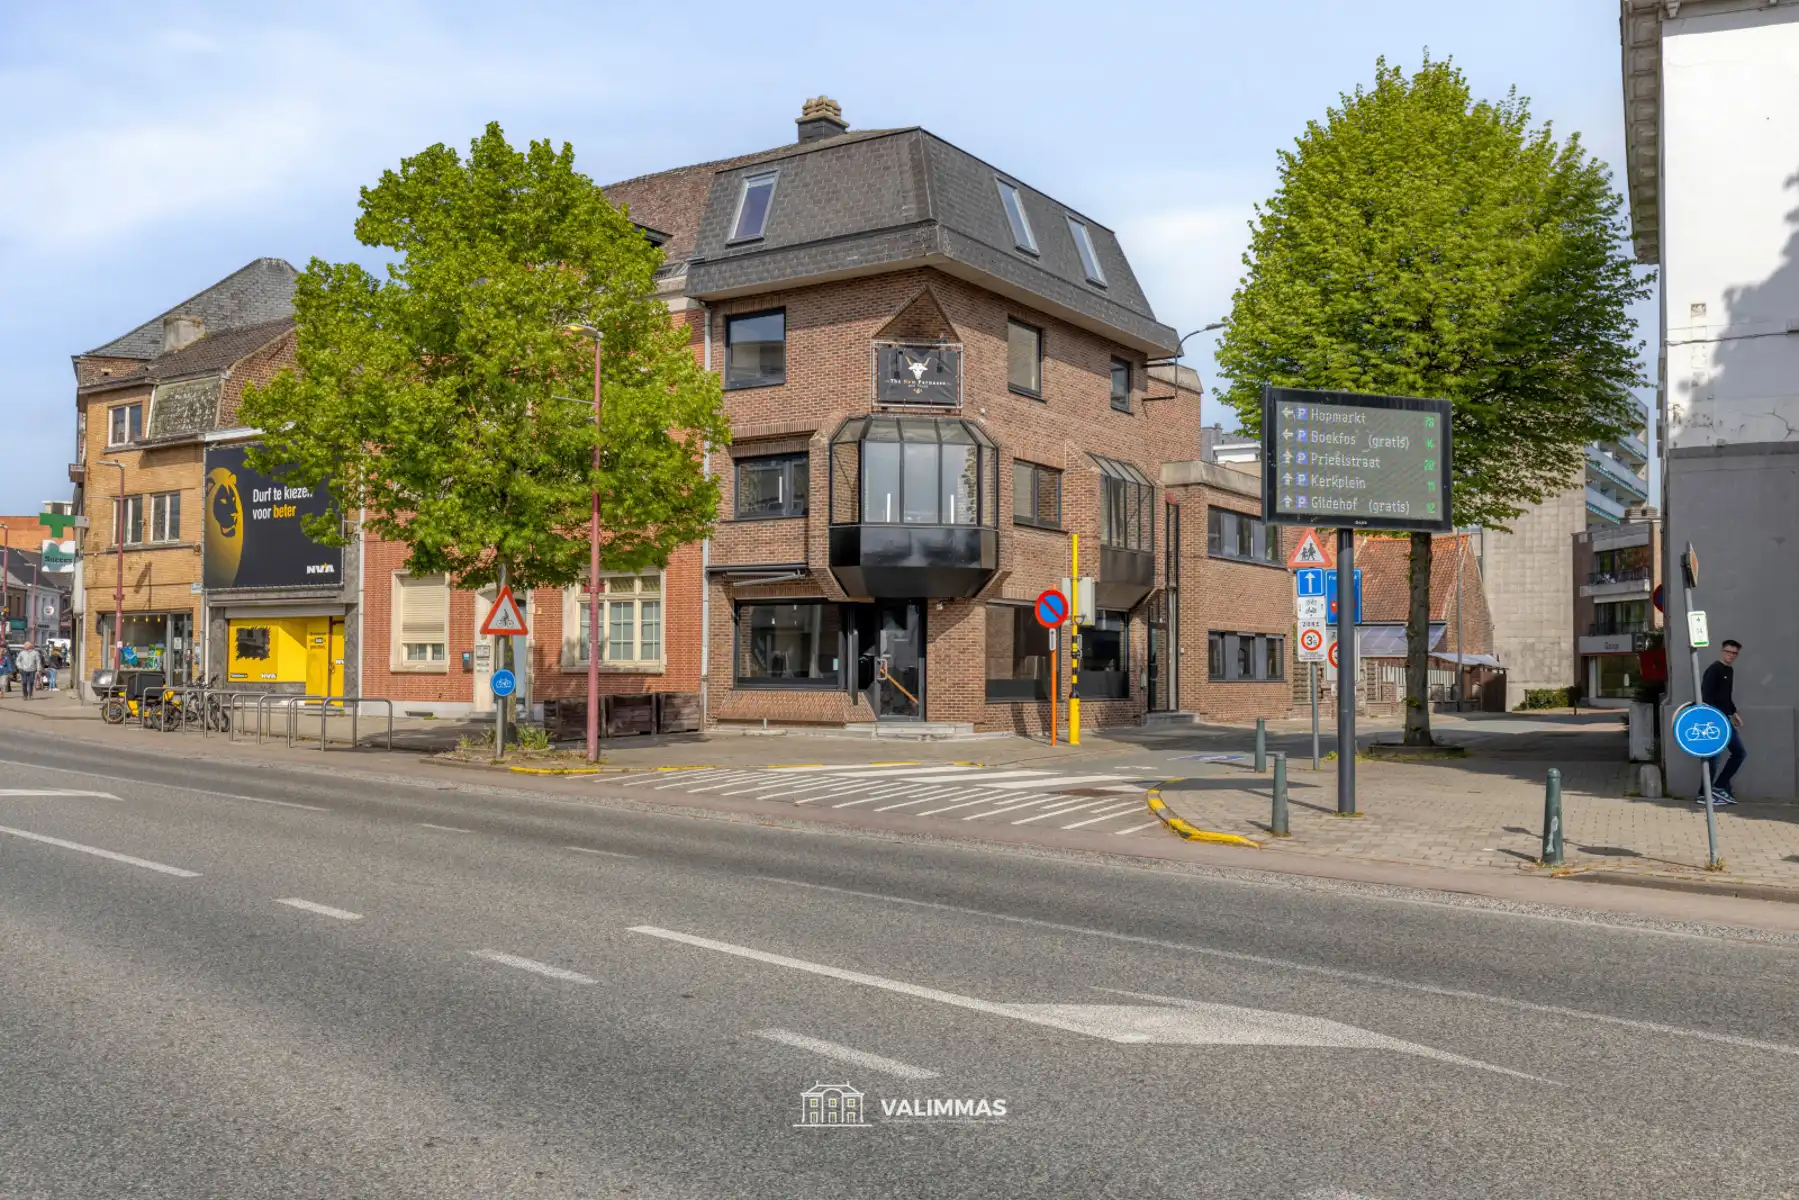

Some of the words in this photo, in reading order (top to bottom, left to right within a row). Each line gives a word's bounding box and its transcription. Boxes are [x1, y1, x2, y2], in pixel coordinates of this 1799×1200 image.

[1311, 408, 1366, 424] Hopmarkt
[1368, 434, 1410, 450] (gratis)
[1311, 452, 1381, 468] Prieelstraat
[1311, 474, 1366, 489] Kerkplein
[253, 488, 271, 503] Durf
[273, 487, 282, 501] te
[253, 507, 272, 520] voor
[273, 503, 297, 519] beter
[1311, 496, 1358, 511] Gildehof
[1369, 500, 1410, 515] (gratis)
